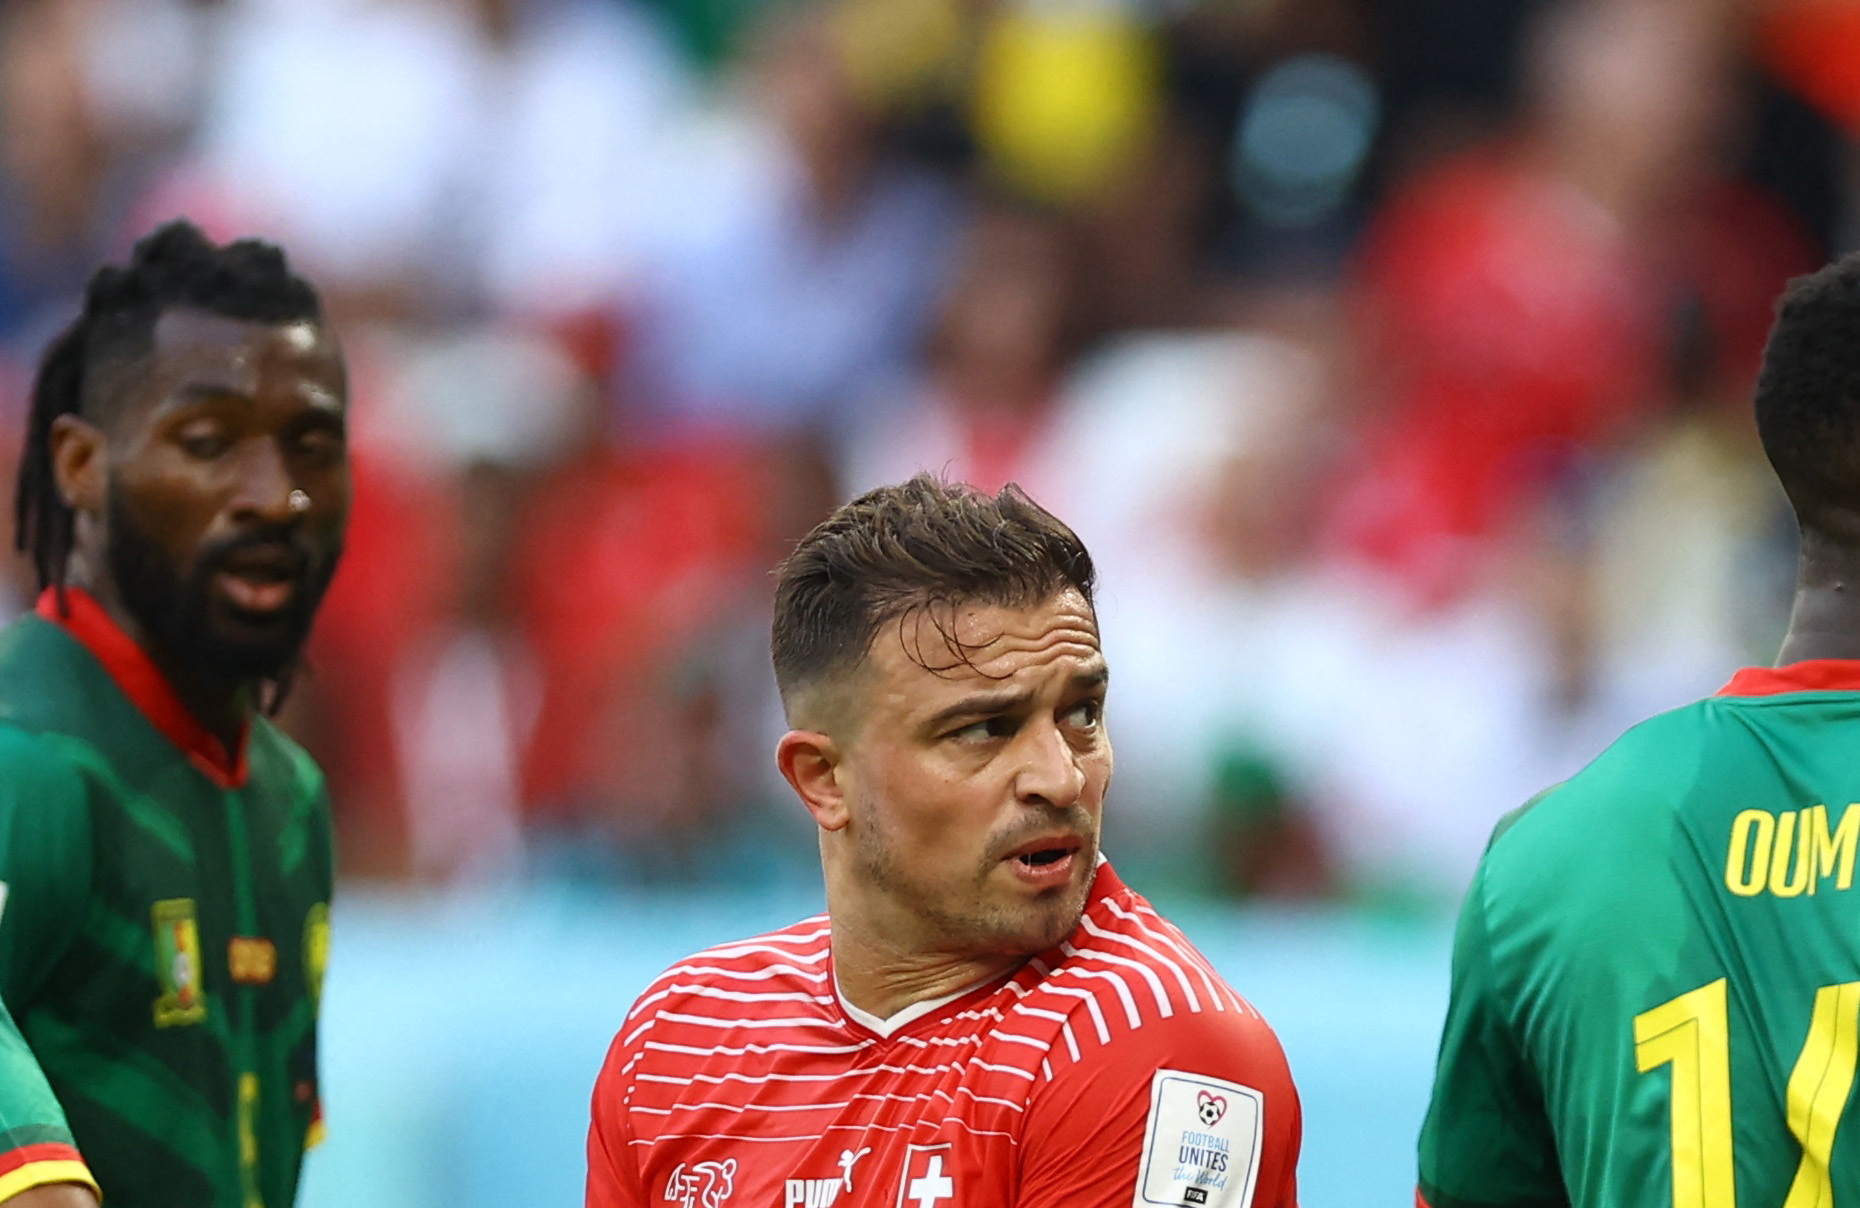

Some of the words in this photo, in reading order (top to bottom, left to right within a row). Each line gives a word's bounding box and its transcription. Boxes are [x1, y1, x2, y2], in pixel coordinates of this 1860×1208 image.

[1181, 1131, 1230, 1153] FOOTBALL
[1178, 1145, 1229, 1172] UNITES
[1185, 1187, 1207, 1204] FIFA
